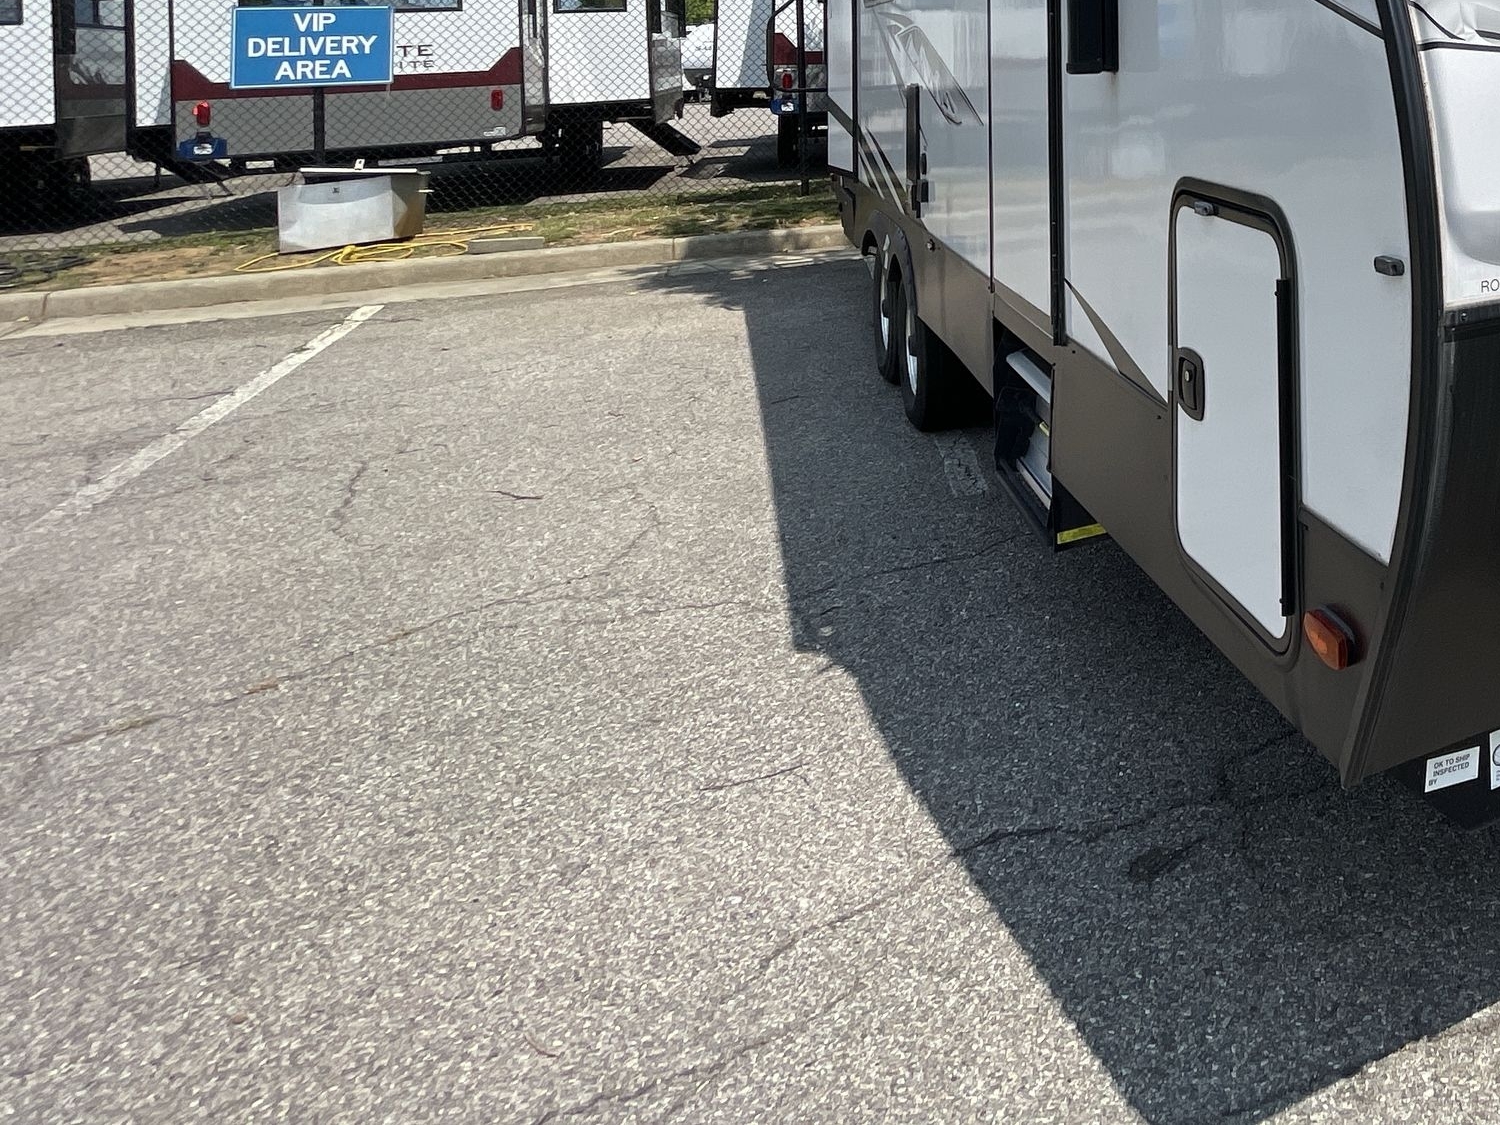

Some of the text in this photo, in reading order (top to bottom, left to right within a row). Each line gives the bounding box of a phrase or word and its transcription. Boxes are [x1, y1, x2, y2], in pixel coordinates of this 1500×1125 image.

[294, 13, 336, 32] VIP
[247, 35, 378, 57] DELIVERY
[274, 59, 352, 81] AREA
[1432, 761, 1470, 777] INSPECTED
[1433, 760, 1444, 770] OK
[1455, 754, 1471, 763] SHIP
[1428, 778, 1438, 786] BY
